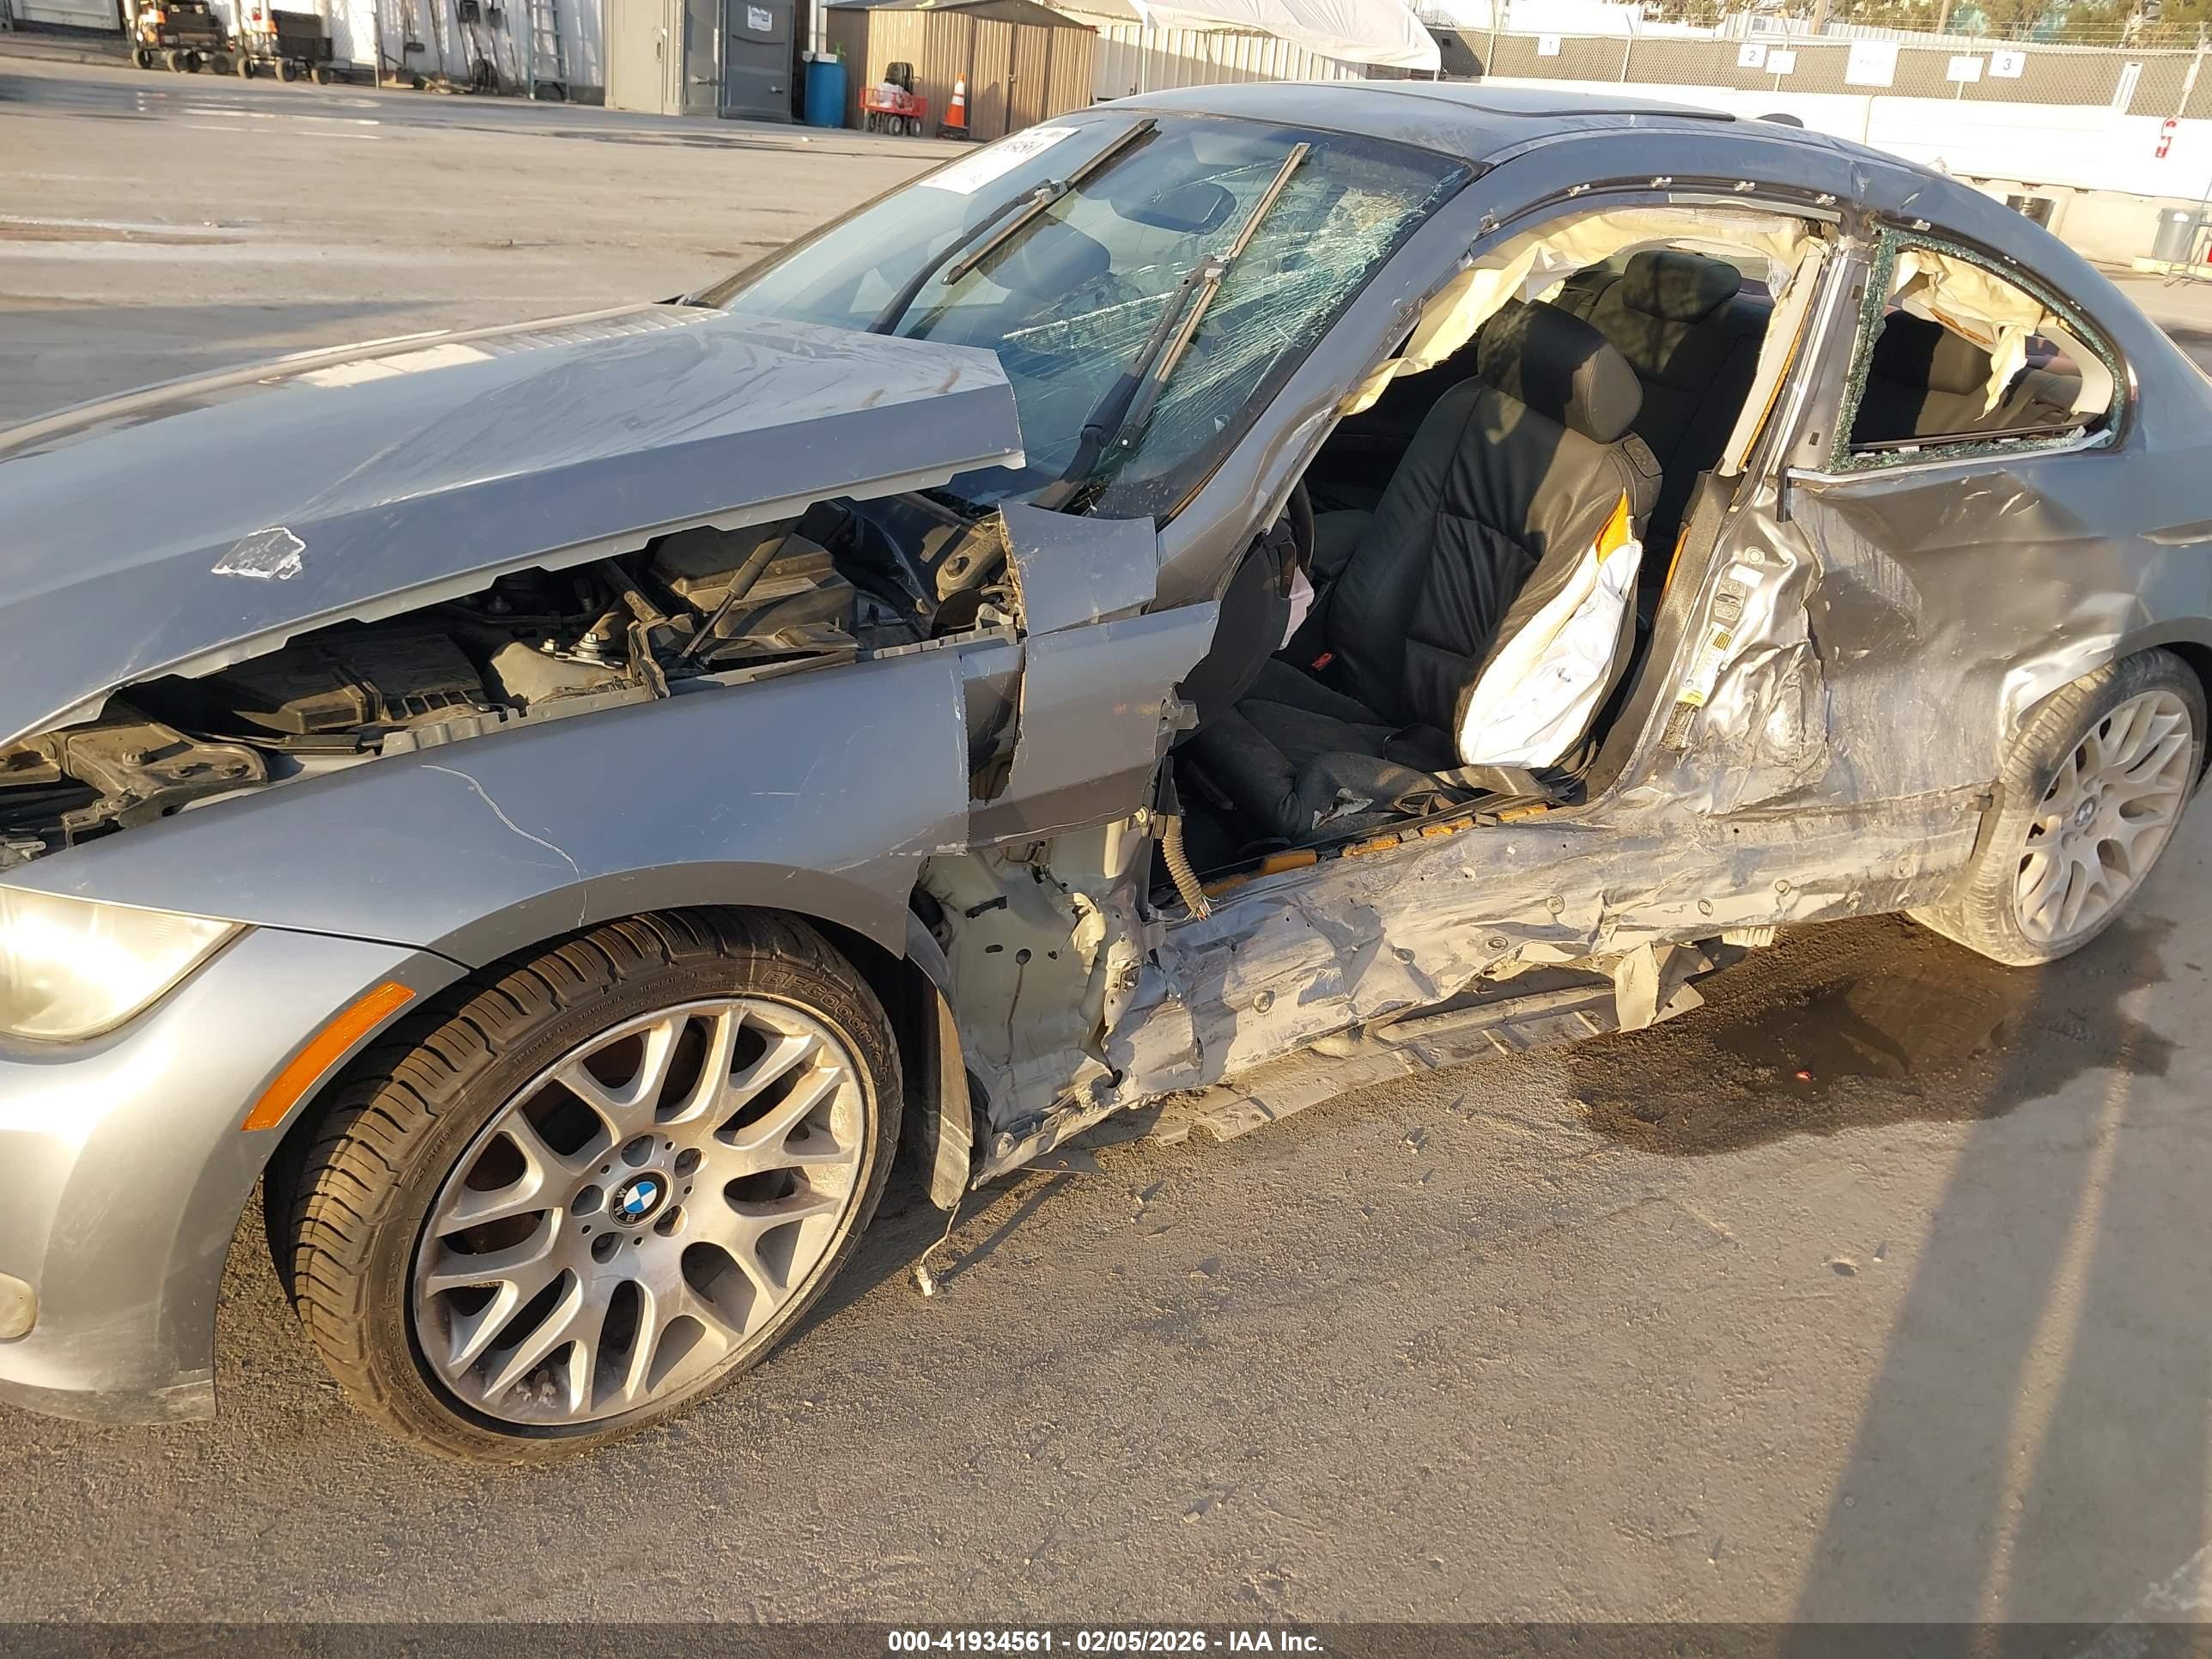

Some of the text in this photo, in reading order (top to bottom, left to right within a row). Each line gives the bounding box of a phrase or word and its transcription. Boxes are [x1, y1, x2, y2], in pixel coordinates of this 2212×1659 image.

[1748, 50, 1756, 61] 2
[2003, 58, 2012, 70] 3
[761, 969, 889, 1086] BFGoodrich
